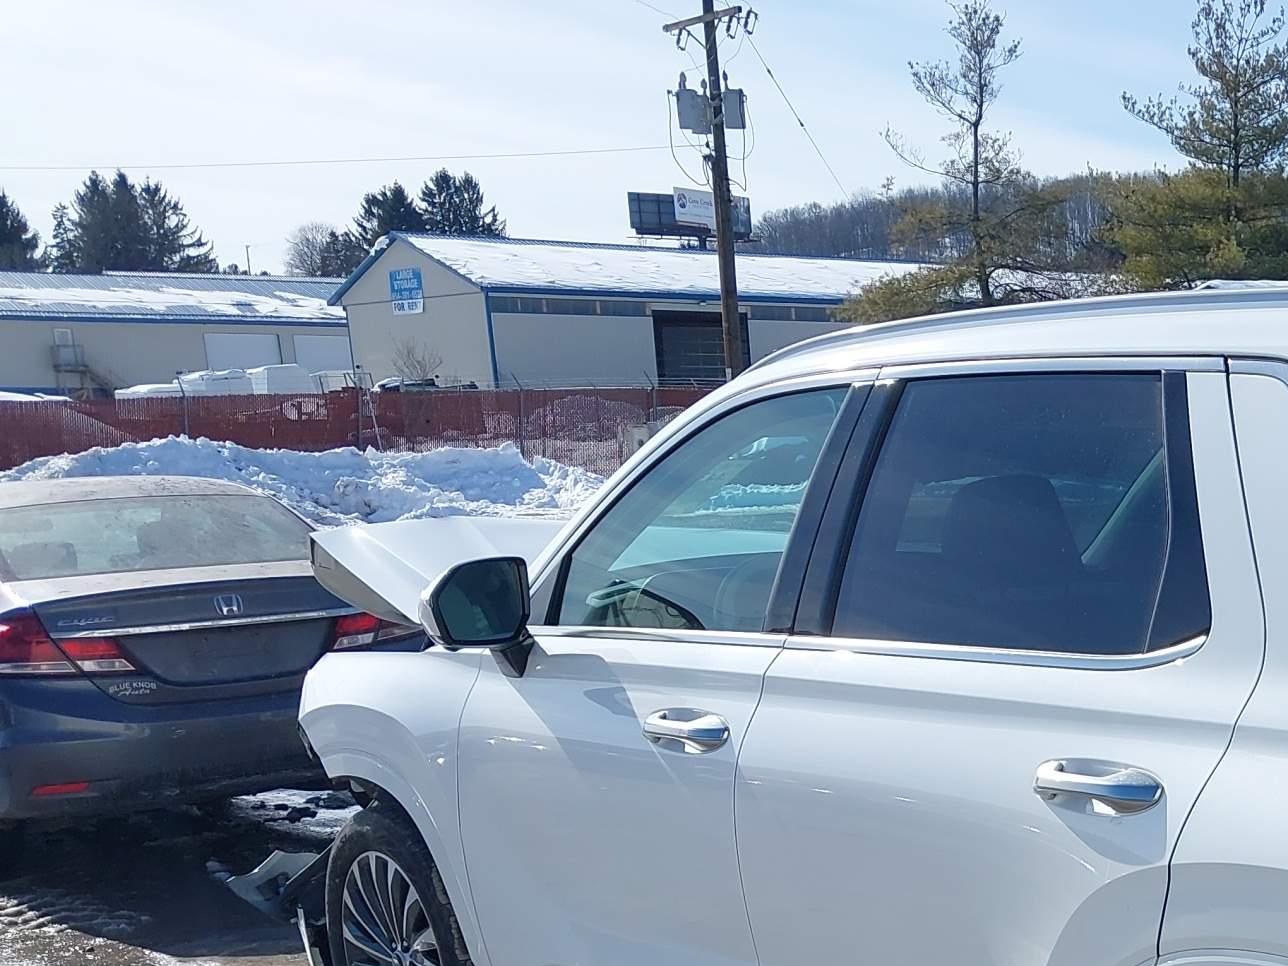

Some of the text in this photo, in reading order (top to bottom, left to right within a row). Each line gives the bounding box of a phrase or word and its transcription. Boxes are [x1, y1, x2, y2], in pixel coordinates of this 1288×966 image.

[393, 301, 422, 312] FOR RENT
[109, 680, 157, 693] BLUE KNOB
